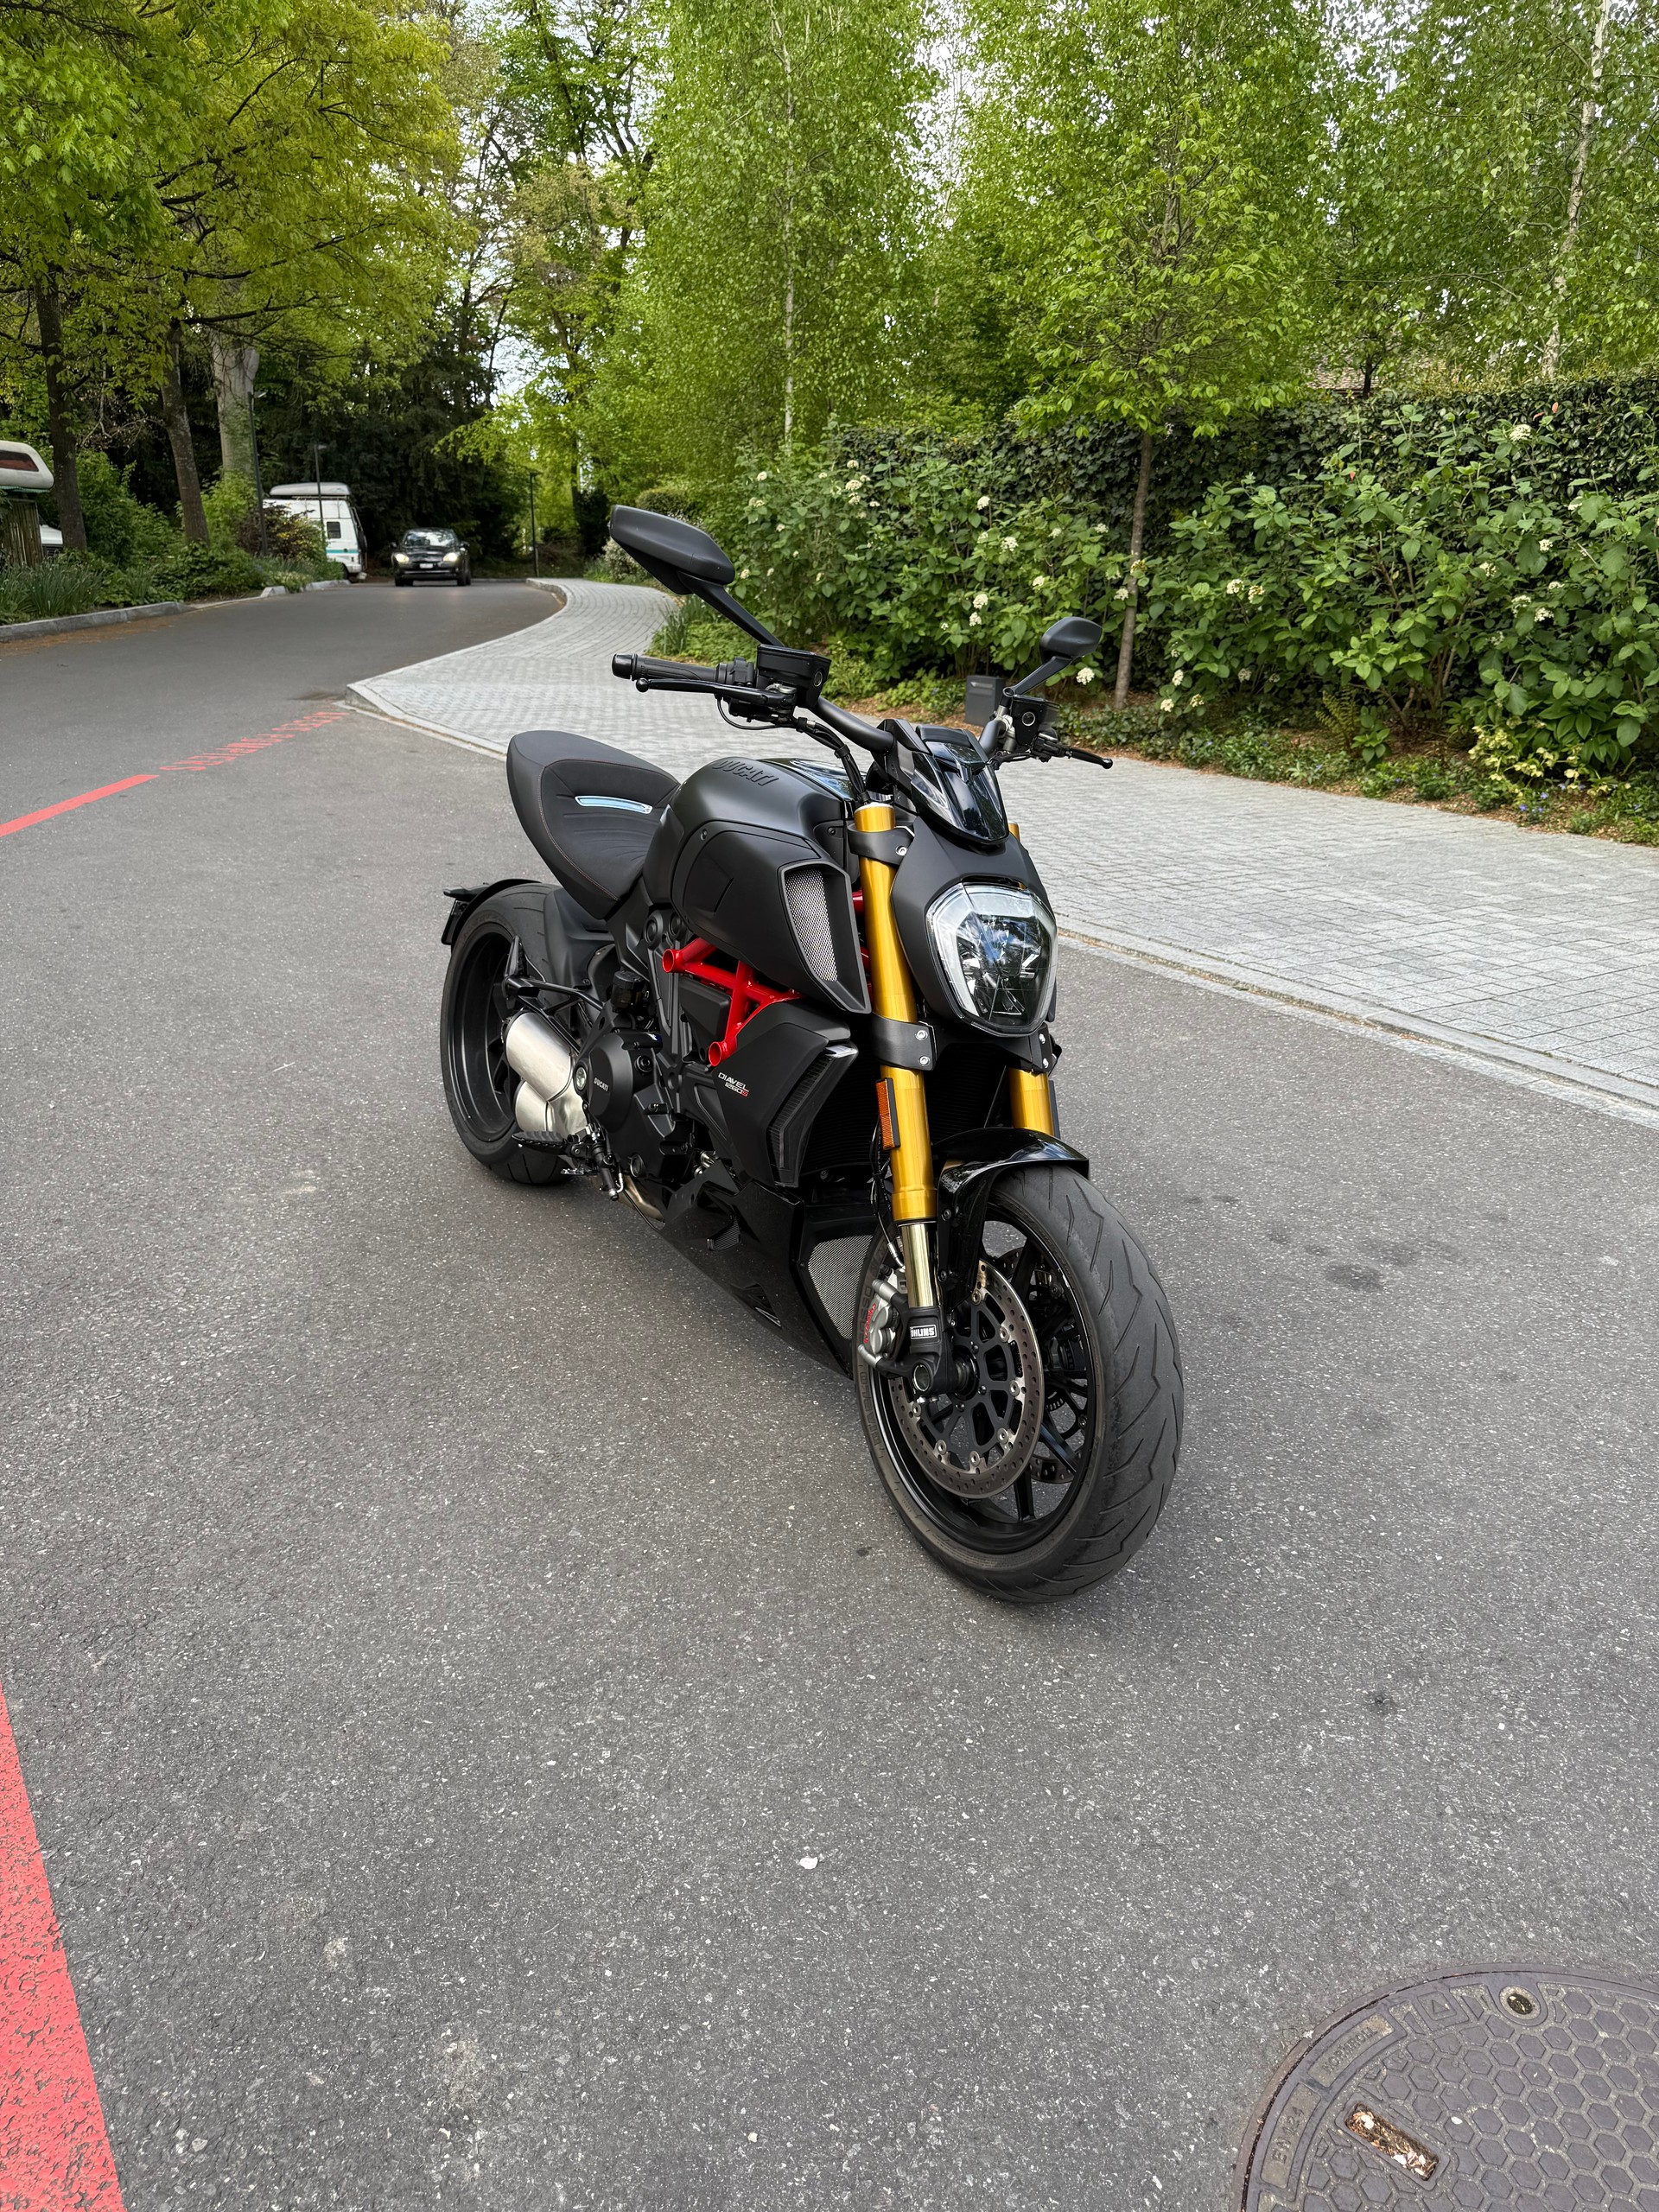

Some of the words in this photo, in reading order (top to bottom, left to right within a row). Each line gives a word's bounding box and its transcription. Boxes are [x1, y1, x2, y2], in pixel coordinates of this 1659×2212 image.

[594, 1077, 609, 1092] DUCATI
[718, 1071, 749, 1092] DIAVEL
[1282, 2107, 1305, 2136] 124
